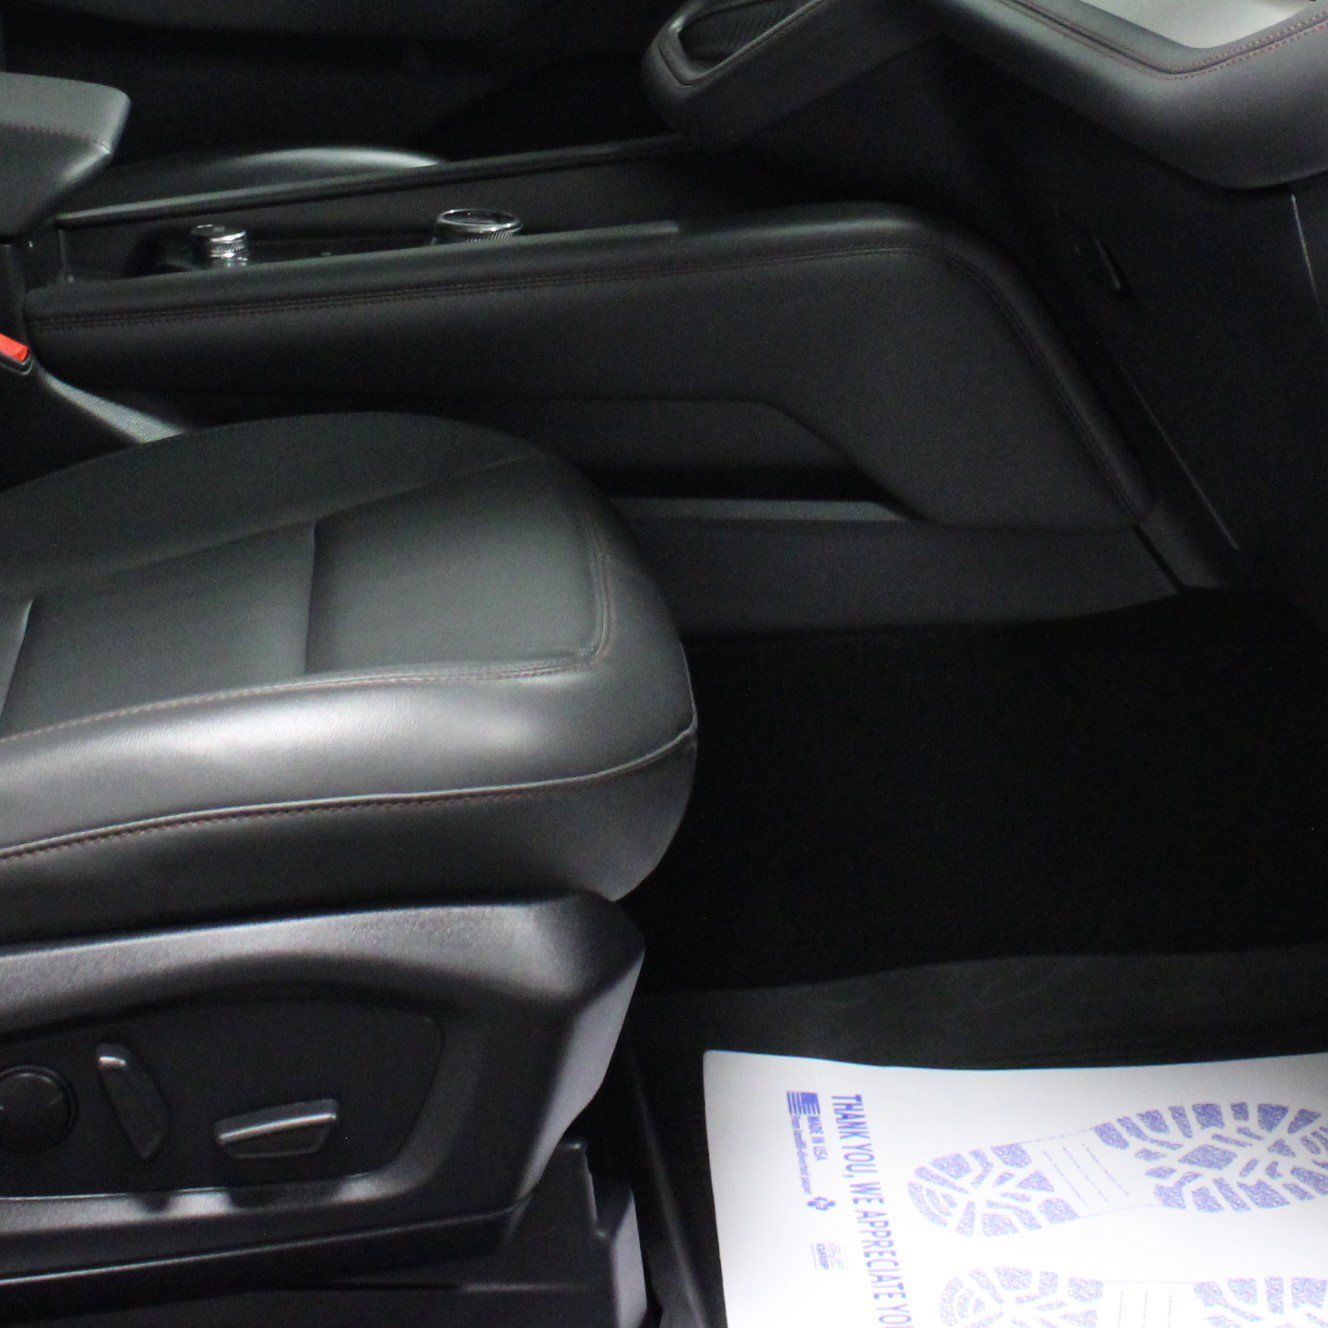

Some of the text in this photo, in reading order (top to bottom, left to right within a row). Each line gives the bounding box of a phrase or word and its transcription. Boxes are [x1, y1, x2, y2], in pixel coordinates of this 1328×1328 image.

[814, 1146, 828, 1161] USA
[830, 1094, 915, 1328] THANK YOU, WE APPRECIATE YO
